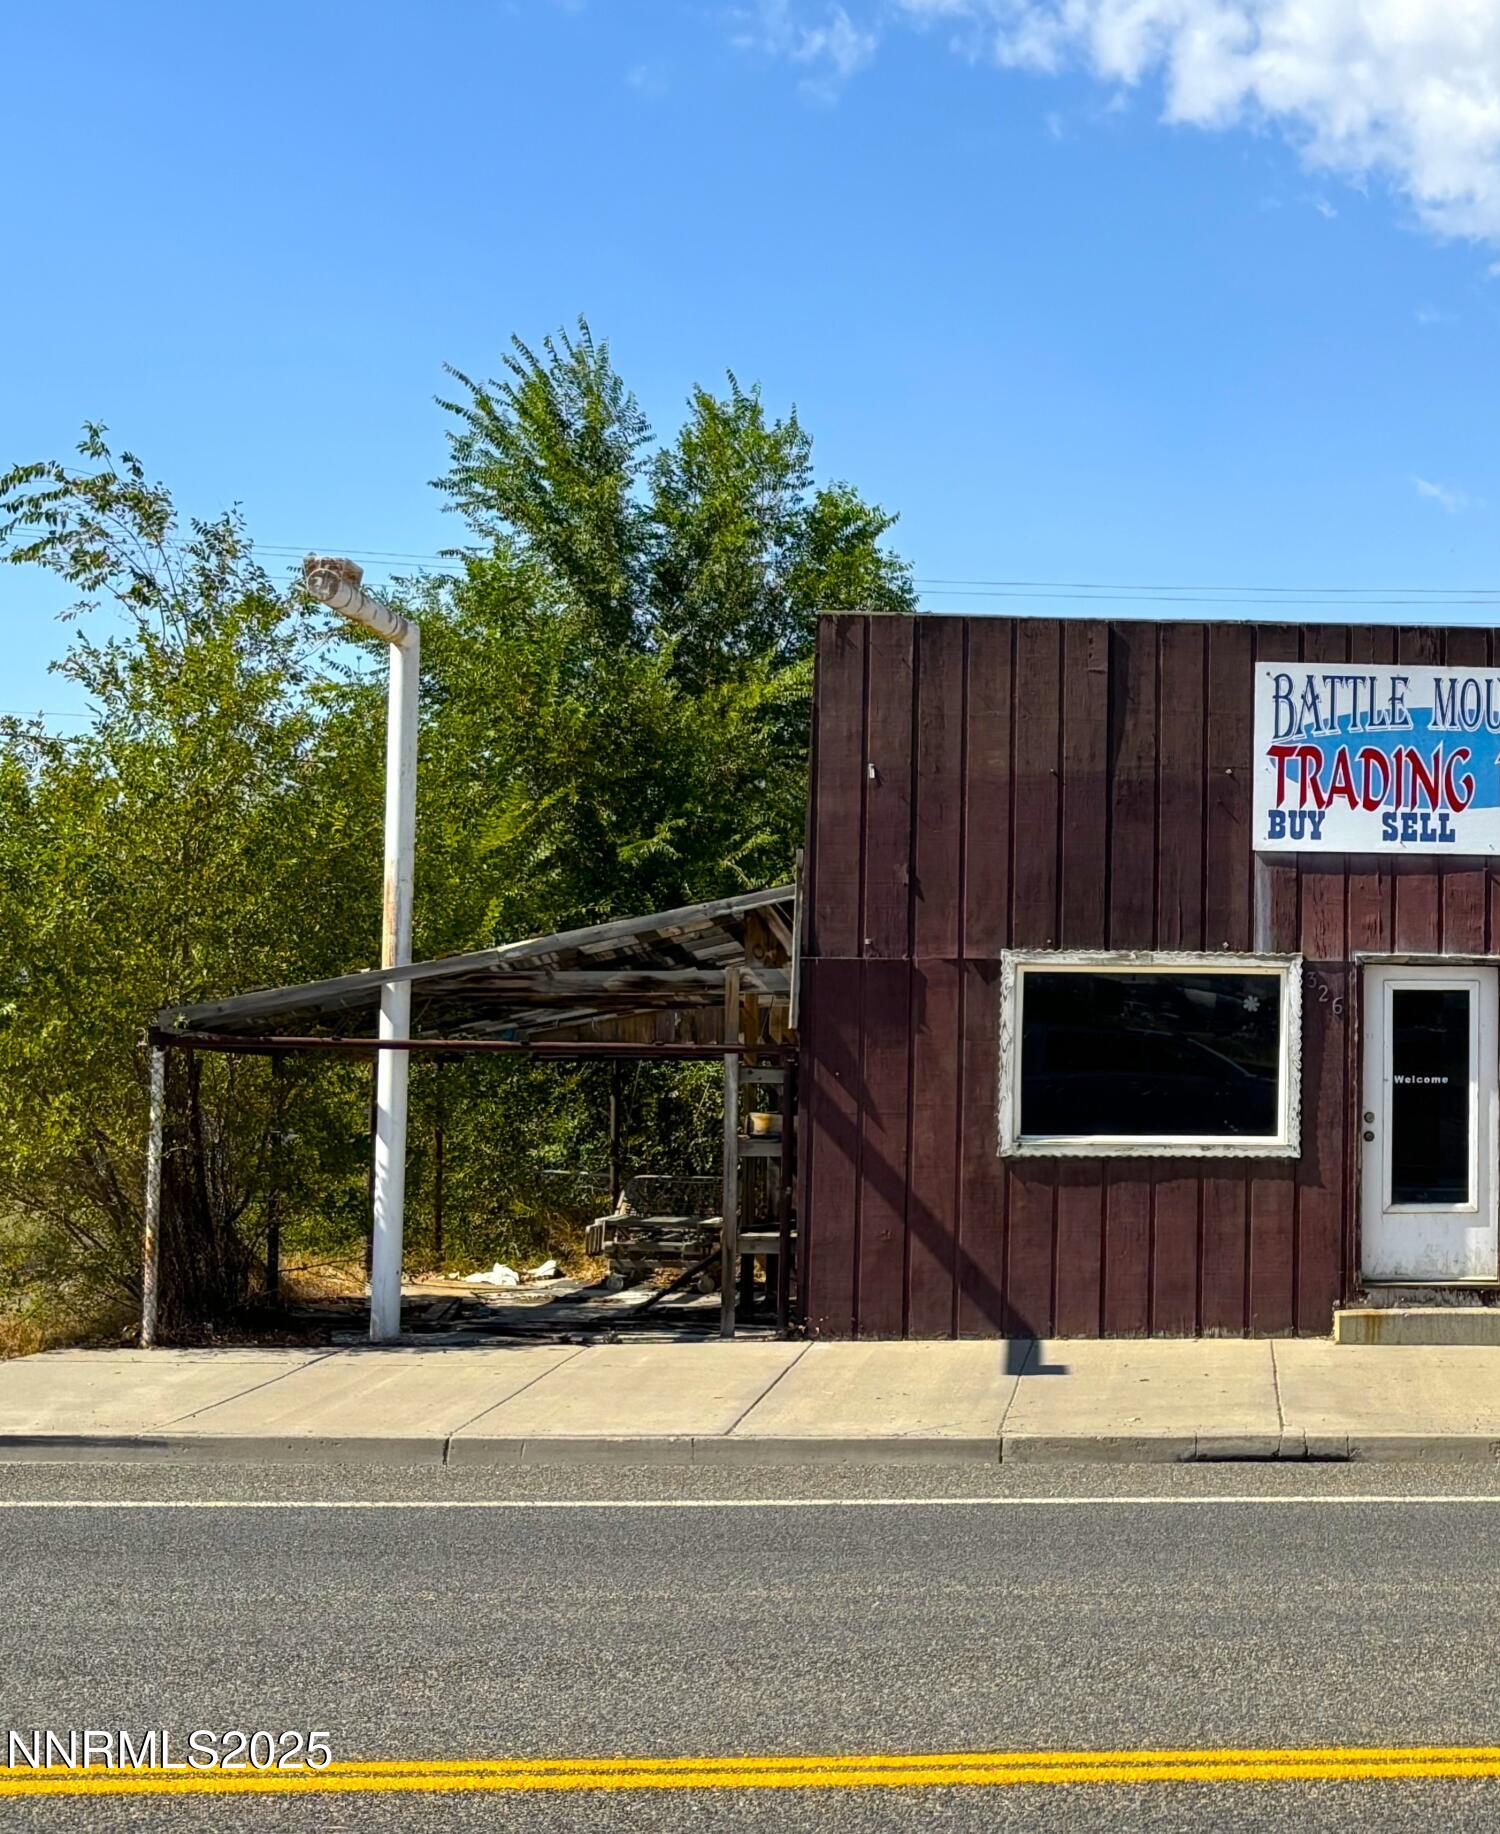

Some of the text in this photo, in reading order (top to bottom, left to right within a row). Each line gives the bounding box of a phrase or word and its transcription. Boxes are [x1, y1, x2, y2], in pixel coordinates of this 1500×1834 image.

[1272, 673, 1412, 741] BATTLE
[1266, 744, 1474, 812] TRADING
[1268, 810, 1326, 840] BUY
[1382, 812, 1456, 842] SELL
[1306, 971, 1343, 1014] 326
[1394, 1074, 1449, 1084] Welcome
